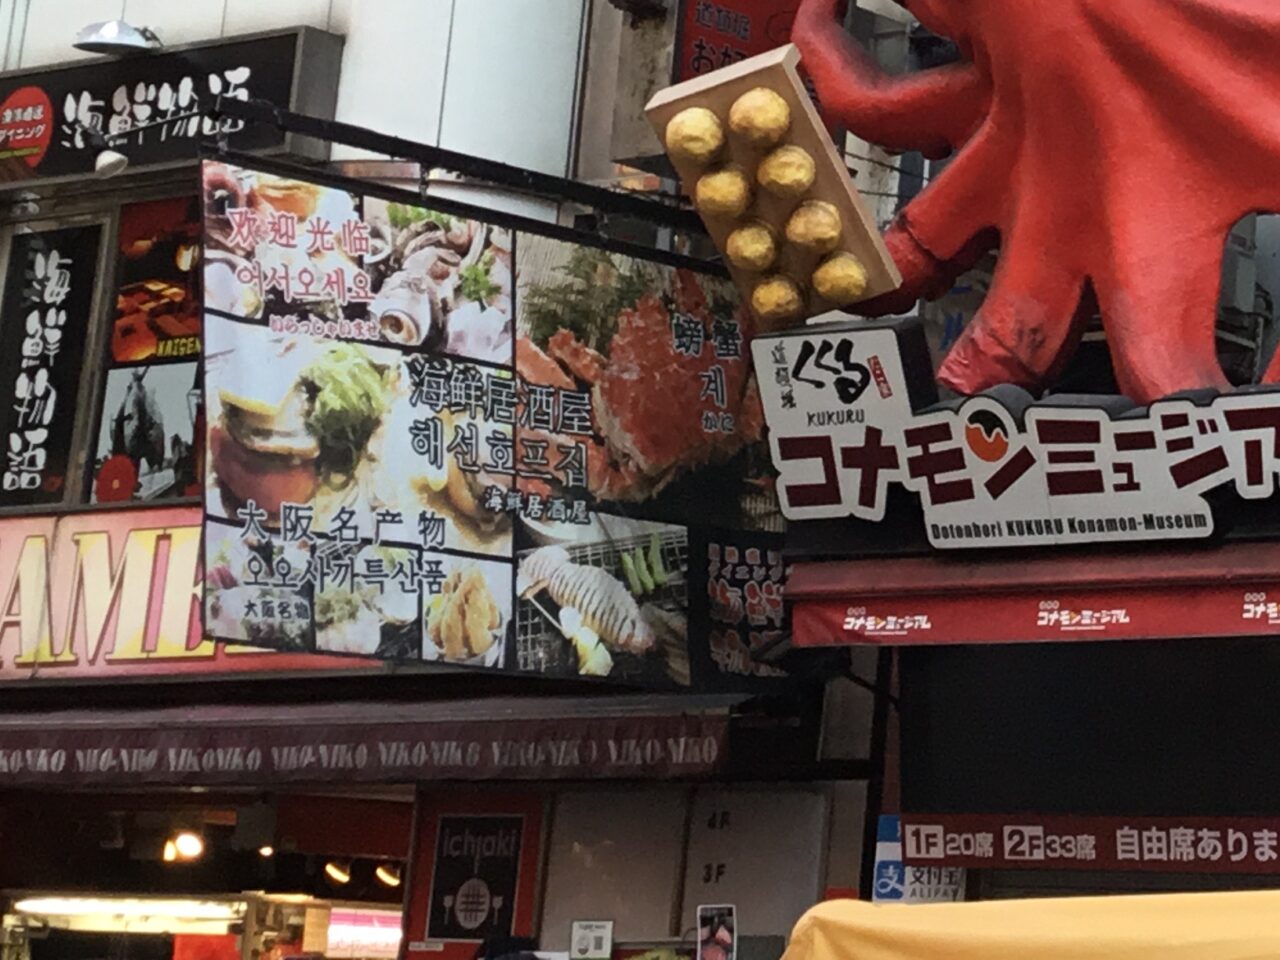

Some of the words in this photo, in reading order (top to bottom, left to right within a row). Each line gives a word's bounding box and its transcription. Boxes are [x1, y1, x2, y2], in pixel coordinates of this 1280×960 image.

[226, 209, 371, 255] 欢迎光临
[236, 261, 377, 303] 어서오세요
[791, 337, 872, 405] くくる
[807, 408, 865, 428] KUKURU
[409, 418, 589, 488] 해선호프집
[236, 502, 447, 546] 大阪名产物
[931, 523, 1003, 540] Dotonbori
[1005, 519, 1063, 537] KUKURU
[1068, 513, 1208, 534] Konamon-Museum
[243, 554, 448, 595] 오오사까특산품
[244, 600, 311, 621] 大阪名物
[910, 827, 940, 856] 1F
[1007, 828, 1043, 858] 2F
[703, 862, 727, 884] 3F
